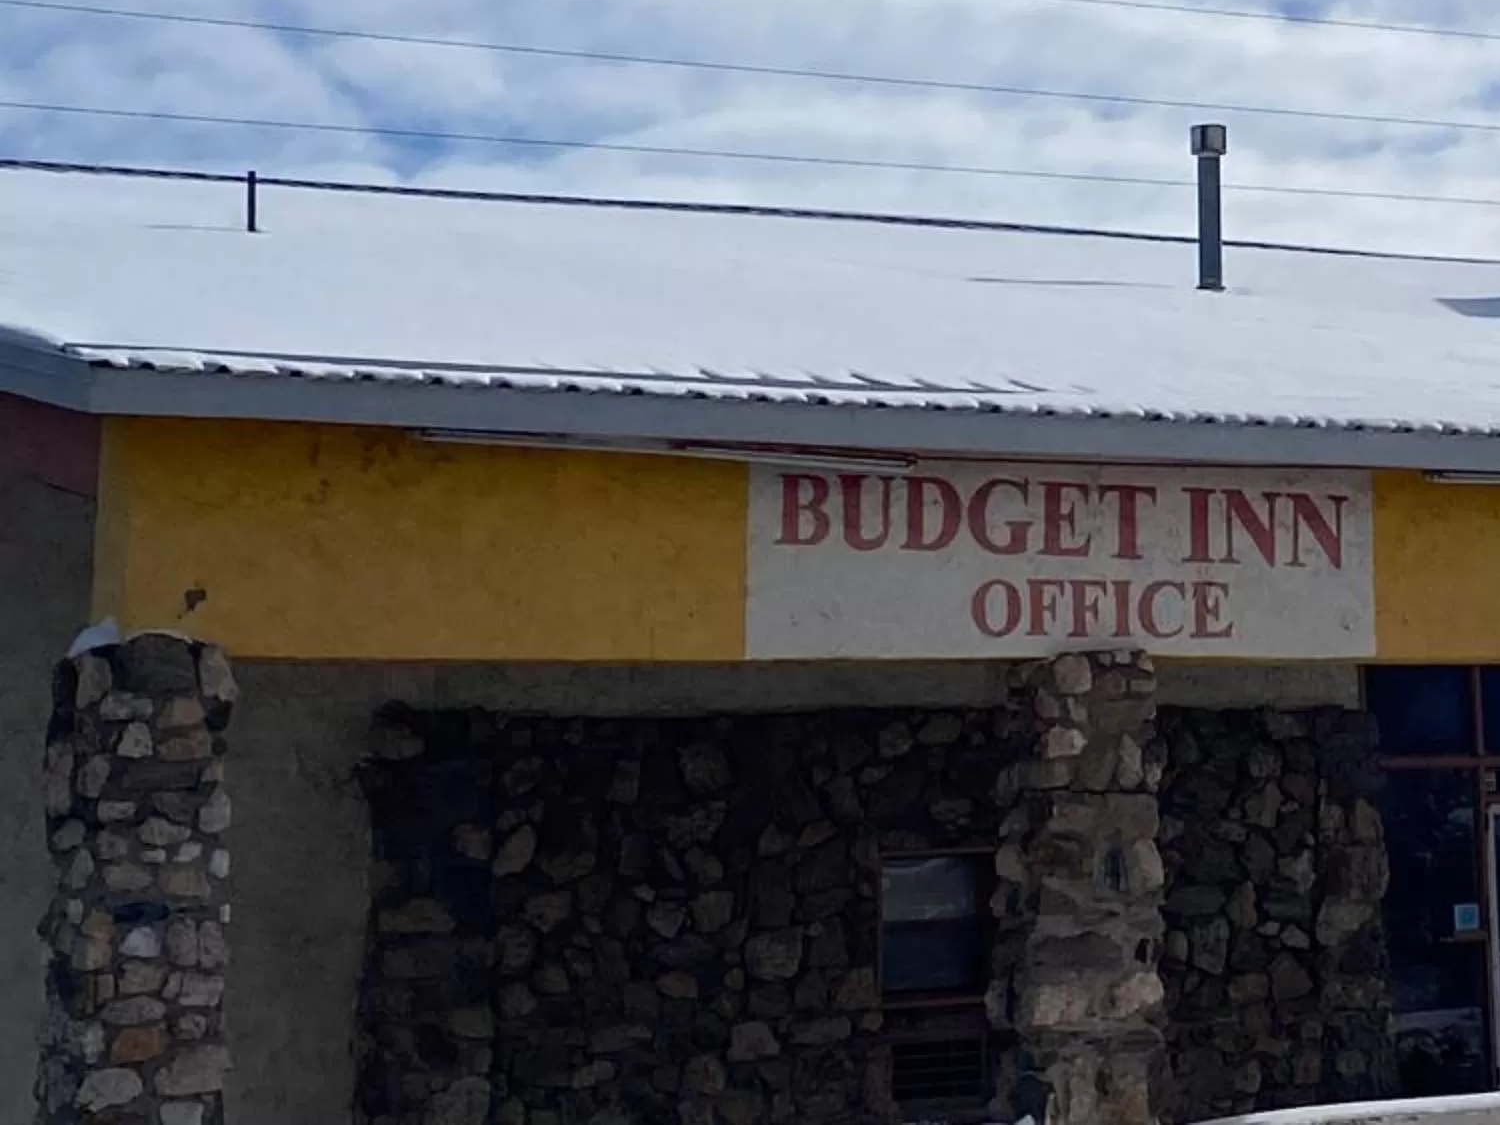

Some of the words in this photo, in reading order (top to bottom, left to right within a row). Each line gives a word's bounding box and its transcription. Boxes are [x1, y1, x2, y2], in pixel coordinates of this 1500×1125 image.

[773, 473, 1157, 562] BUDGET
[1180, 486, 1349, 570] INN
[970, 578, 1234, 639] OFFICE
